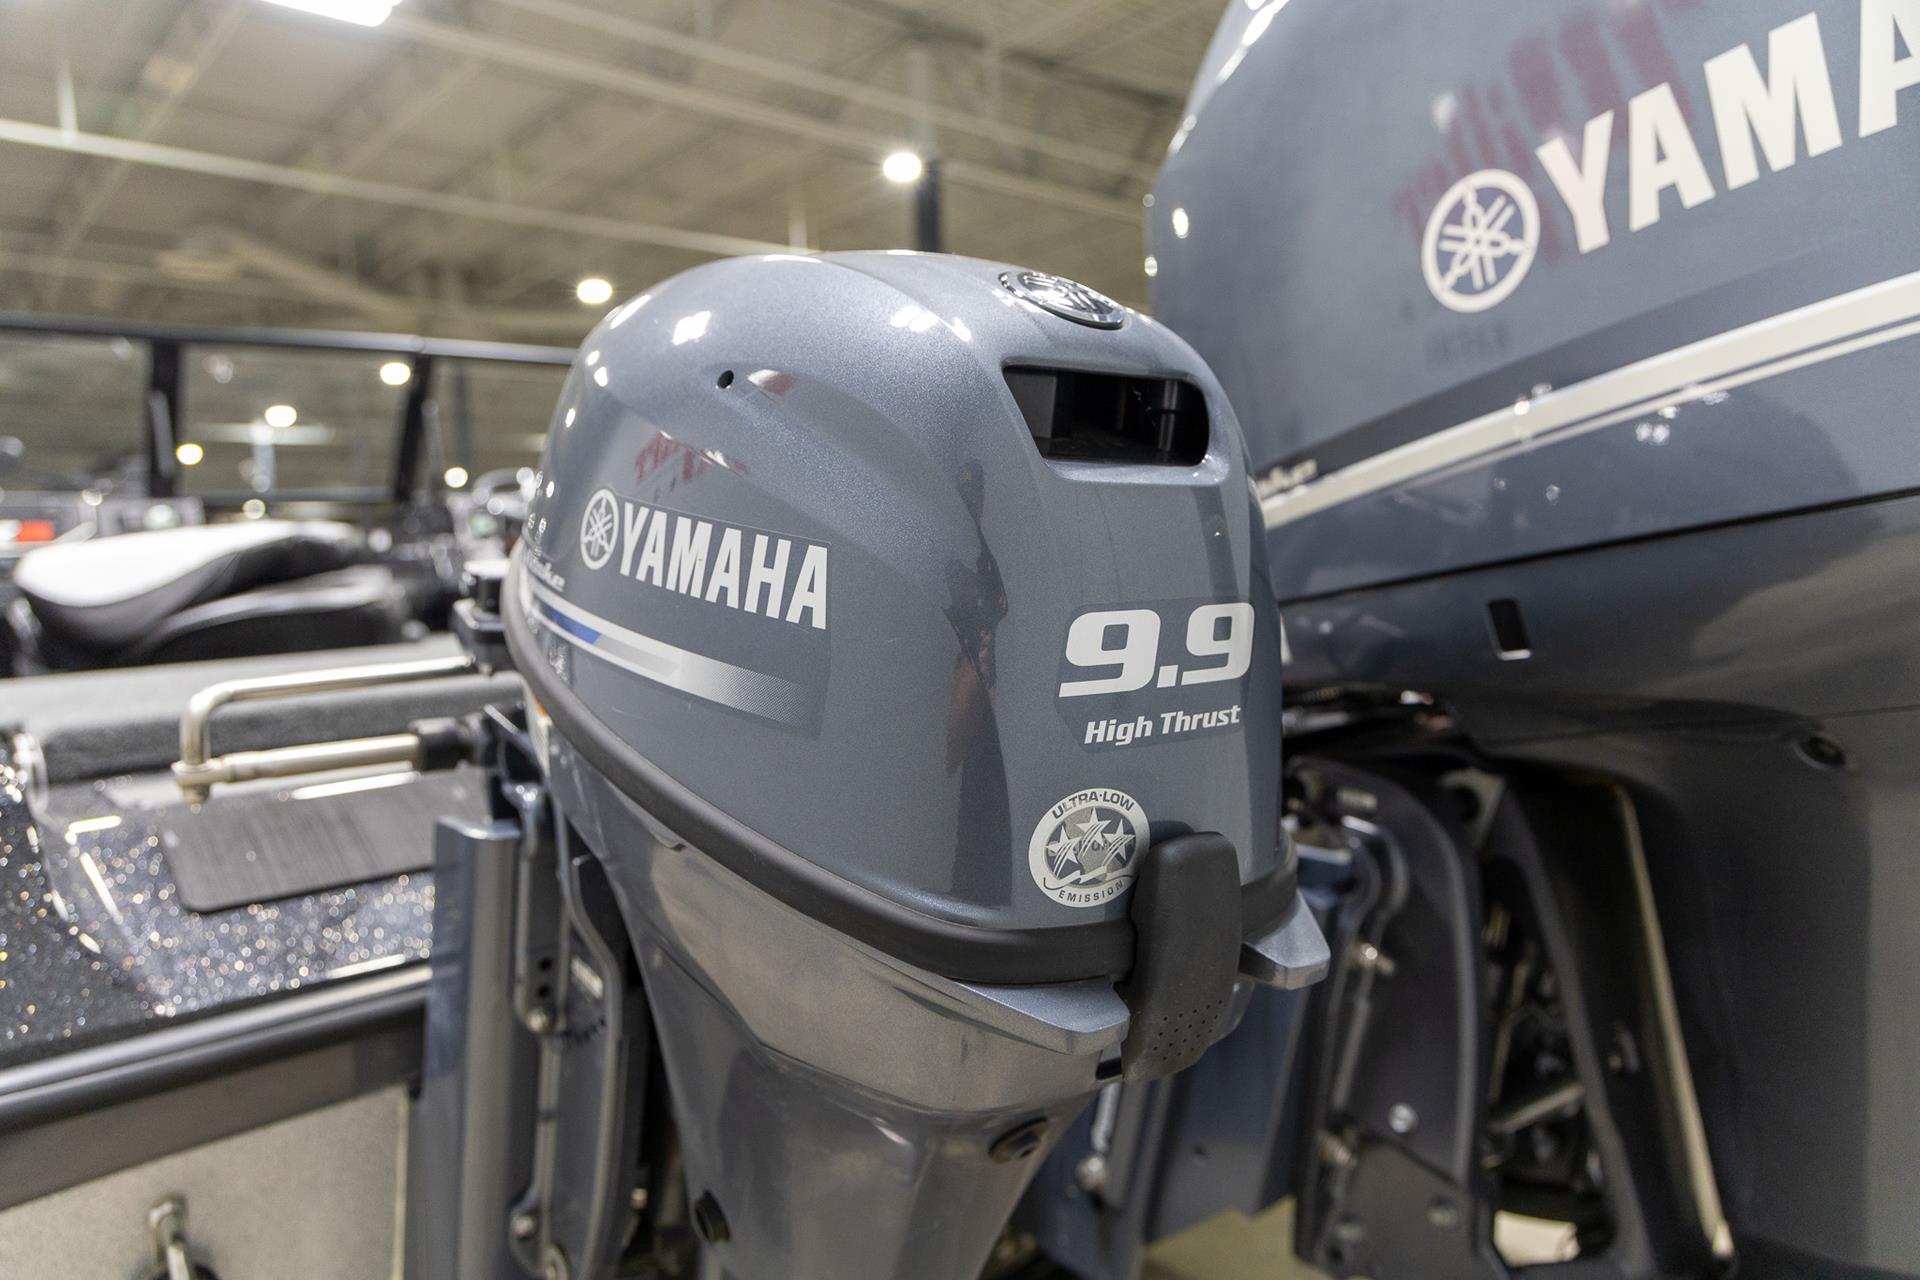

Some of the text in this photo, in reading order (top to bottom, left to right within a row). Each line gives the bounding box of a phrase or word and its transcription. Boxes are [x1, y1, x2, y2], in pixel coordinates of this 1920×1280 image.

[620, 502, 828, 630] YAMAHA
[1059, 602, 1255, 697] 9.9
[1084, 704, 1241, 746] High Thrust
[1058, 881, 1123, 902] EMISSION
